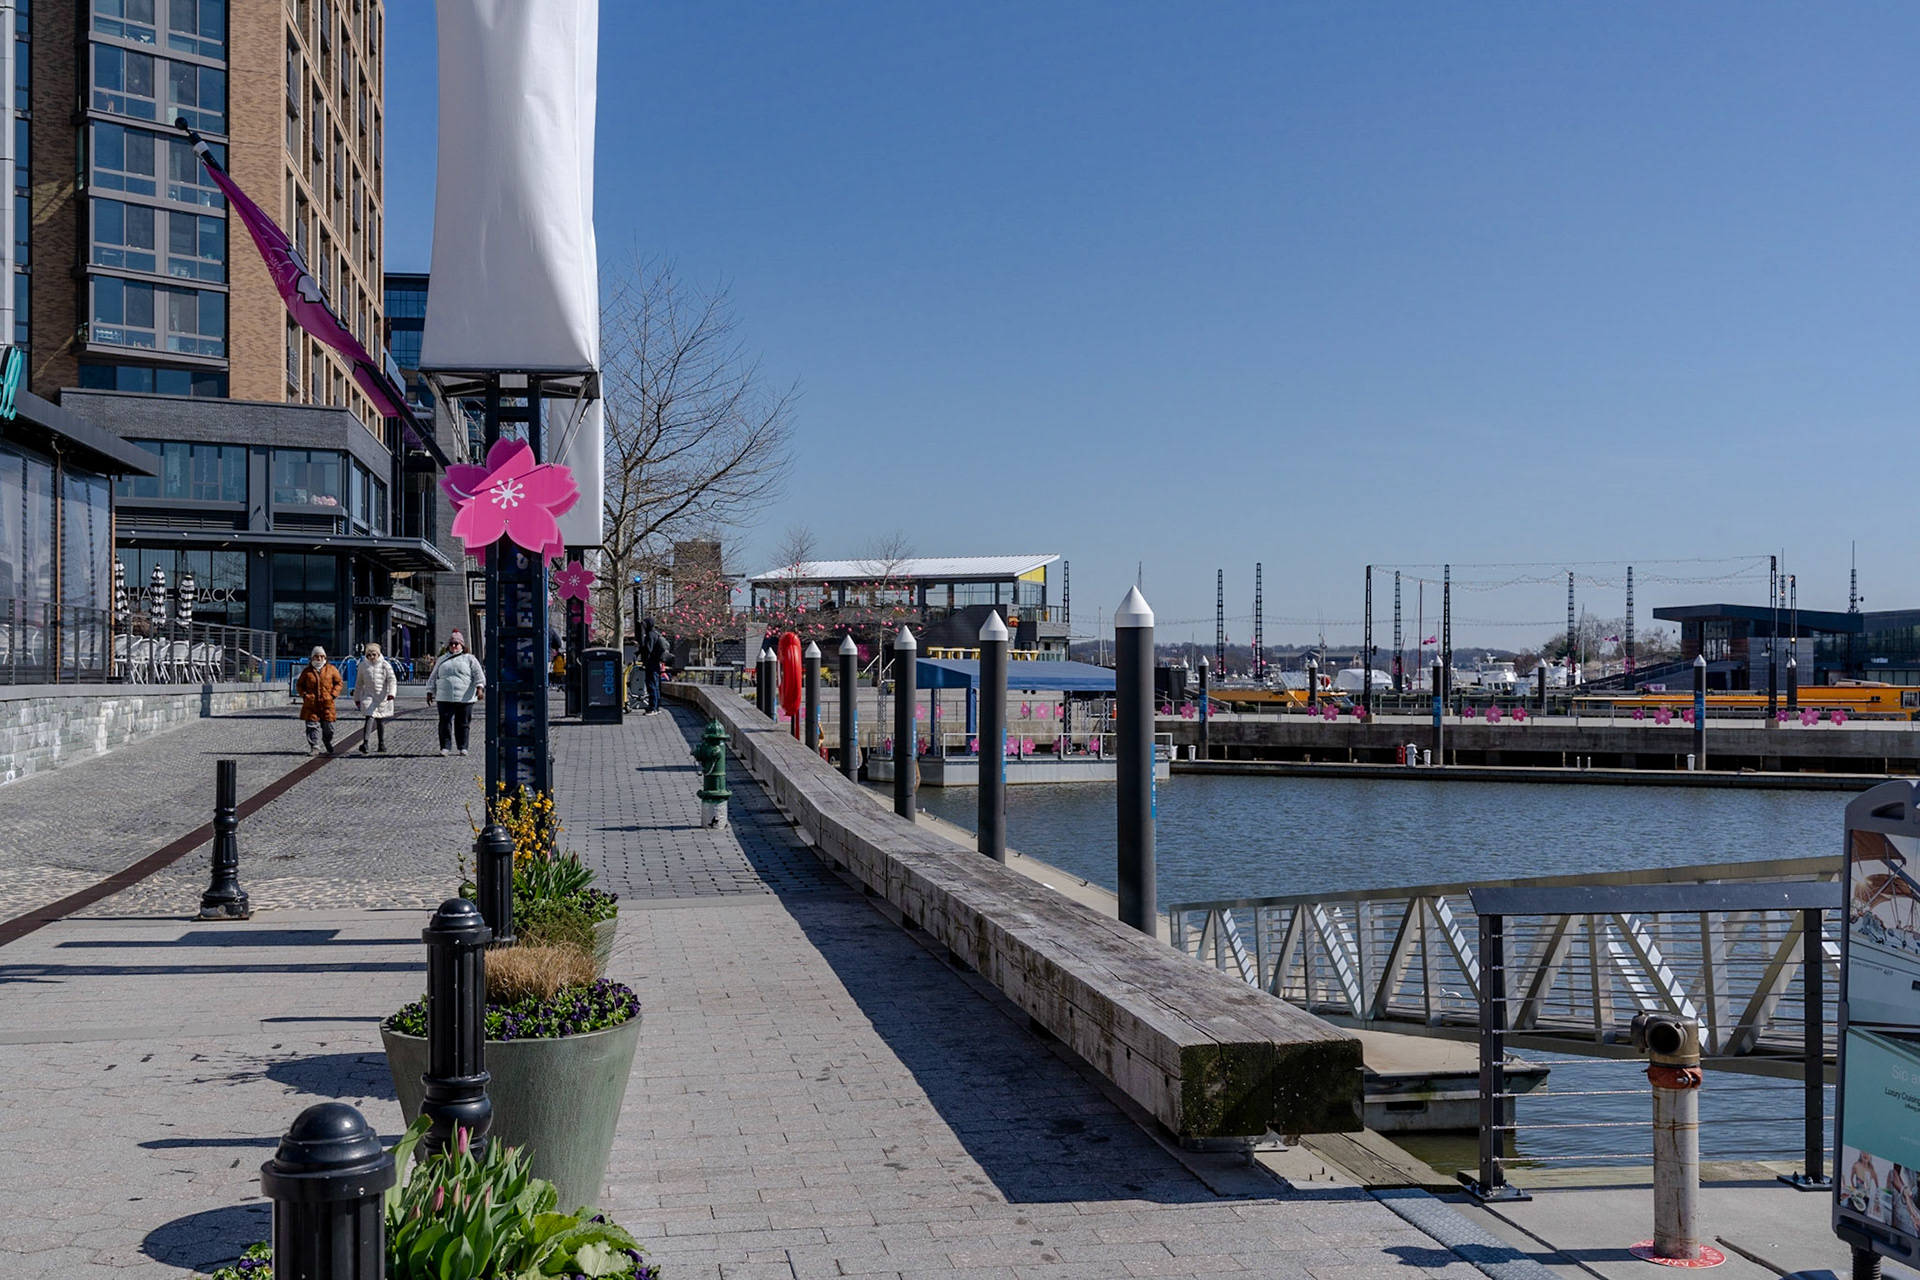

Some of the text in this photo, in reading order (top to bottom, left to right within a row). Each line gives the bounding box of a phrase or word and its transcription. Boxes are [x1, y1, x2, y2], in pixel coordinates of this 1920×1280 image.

[123, 586, 237, 602] HAE HACK
[517, 553, 535, 787] WHAR EVENS
[603, 661, 615, 695] clean
[1892, 1064, 1909, 1082] Sip
